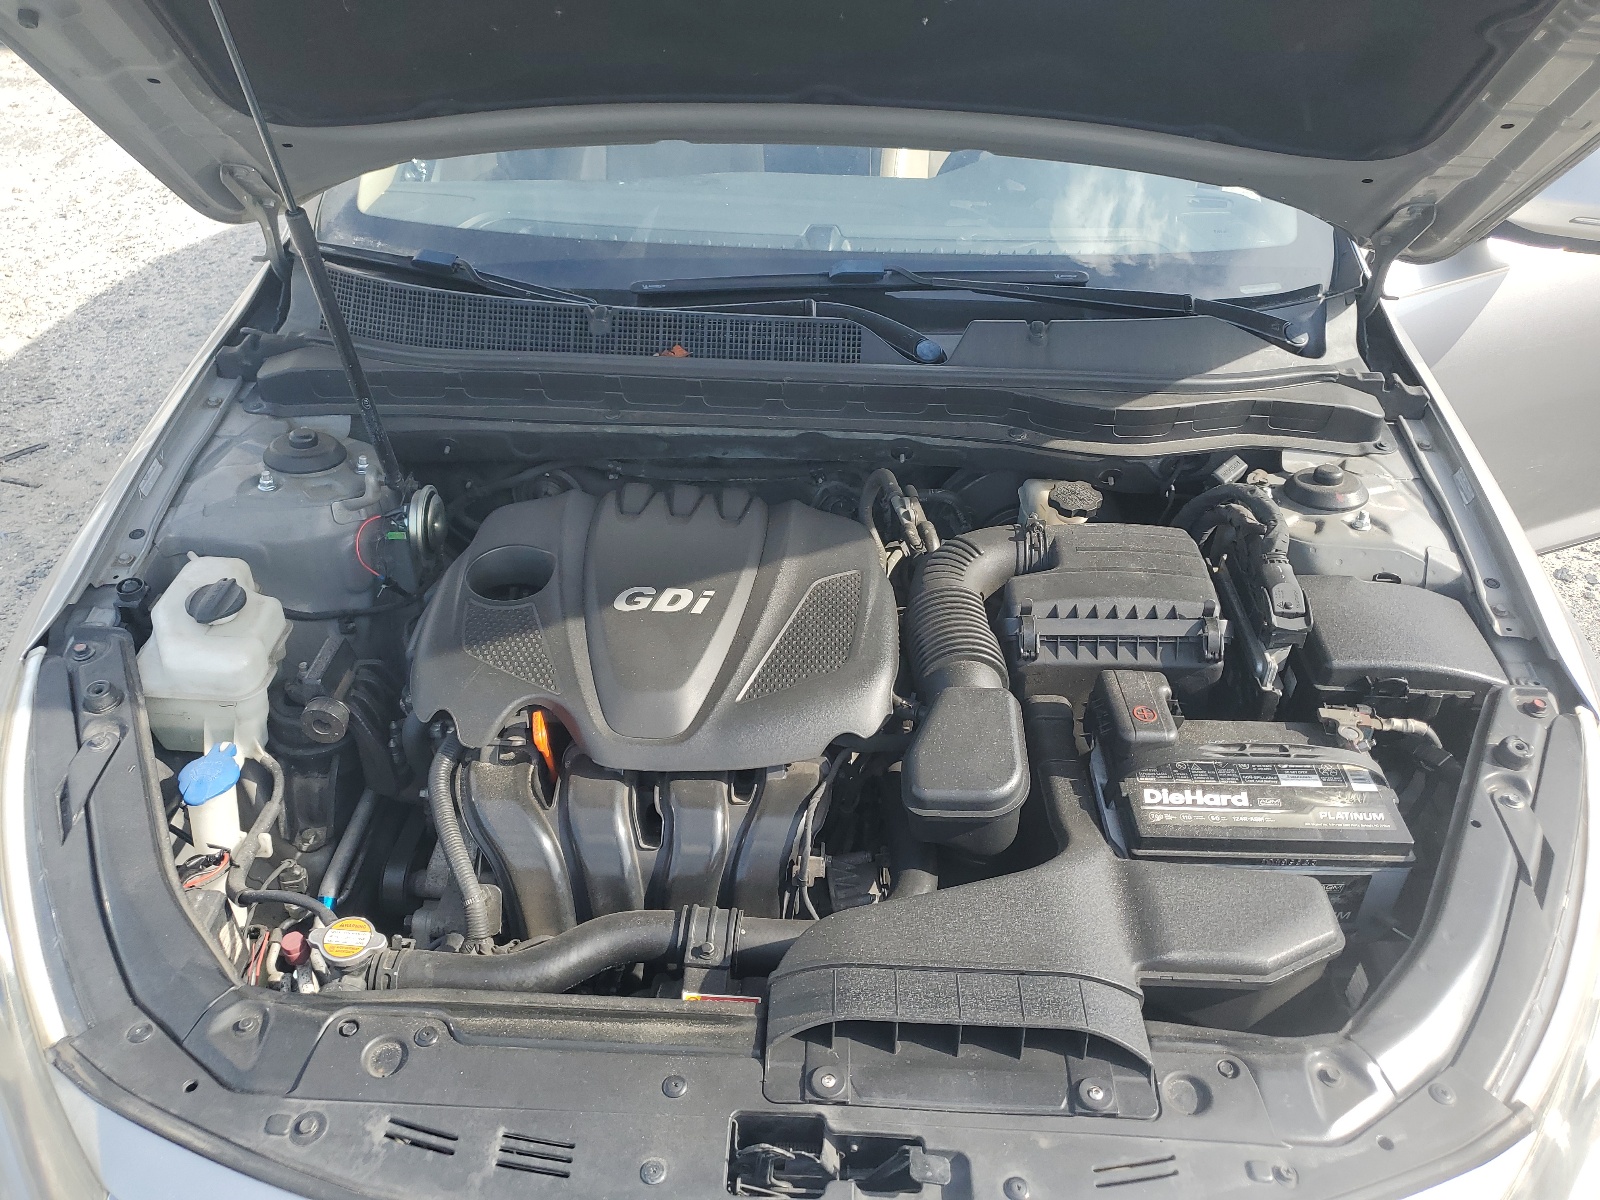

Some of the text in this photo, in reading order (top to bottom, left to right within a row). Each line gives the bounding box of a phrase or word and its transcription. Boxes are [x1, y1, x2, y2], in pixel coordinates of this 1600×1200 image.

[613, 586, 716, 614] GDi
[1143, 788, 1249, 807] DieHard
[1319, 811, 1385, 821] PLATINUM
